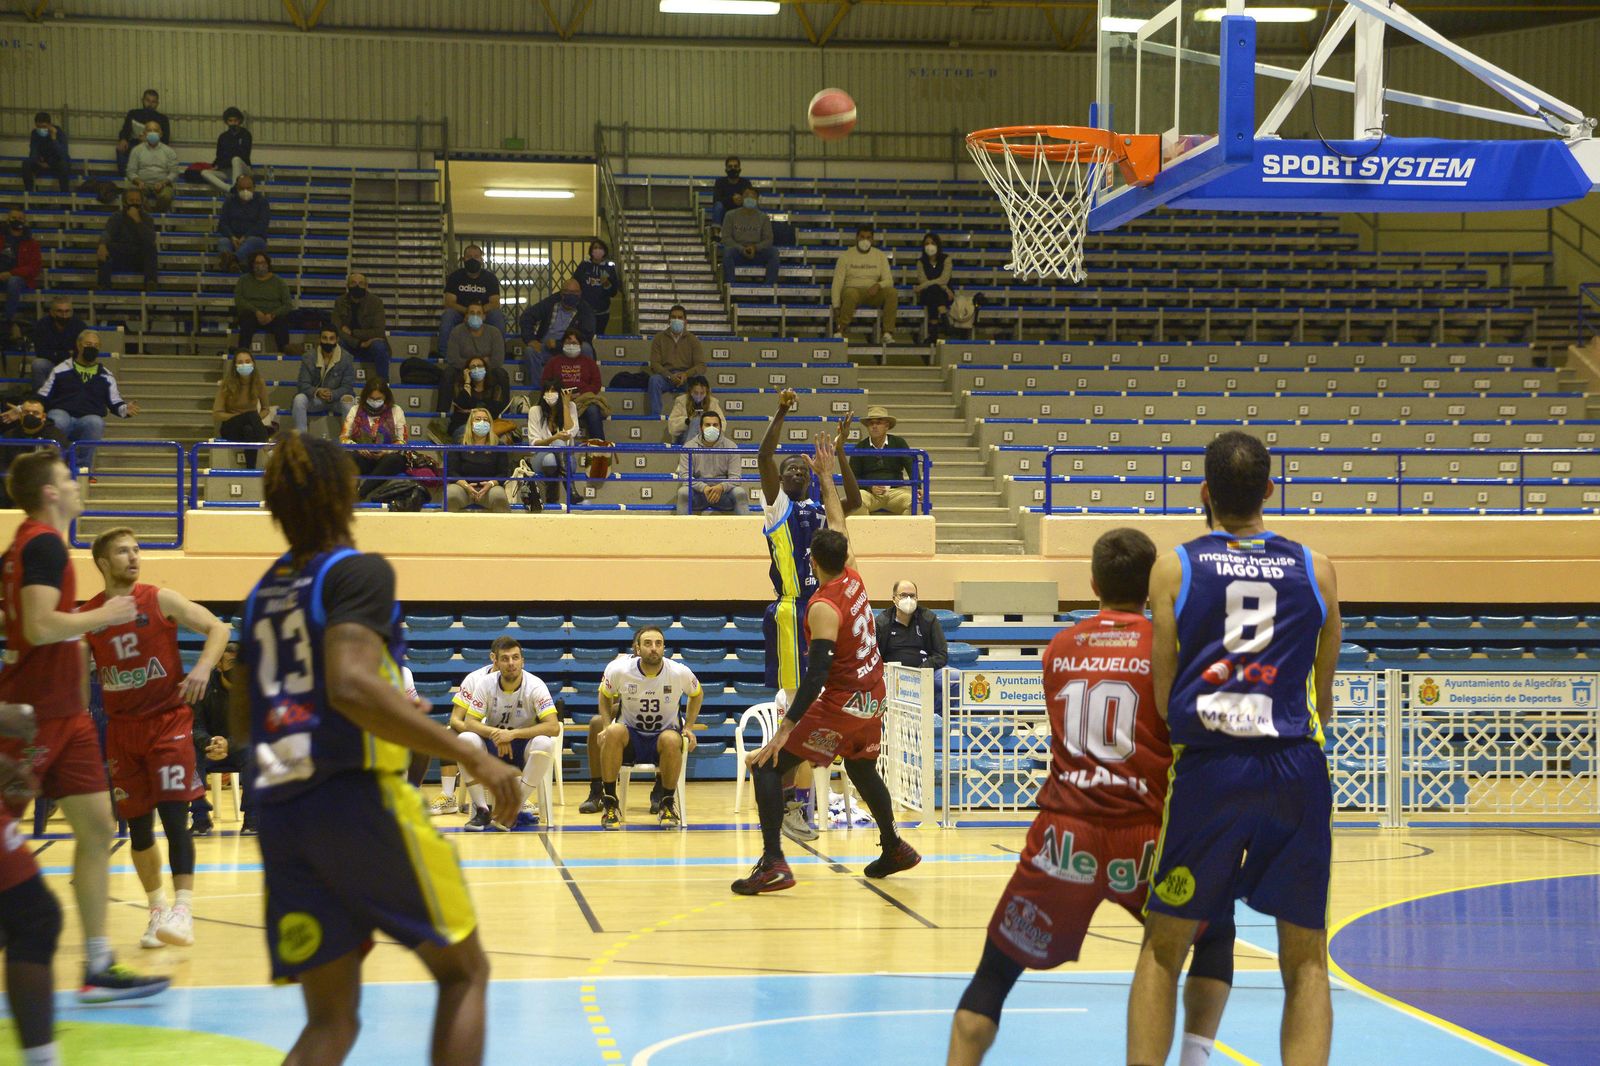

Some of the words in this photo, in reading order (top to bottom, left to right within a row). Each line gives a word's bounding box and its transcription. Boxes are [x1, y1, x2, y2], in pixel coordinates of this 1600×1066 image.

[1262, 154, 1358, 176] SPORT
[1359, 156, 1476, 184] SYSTEM
[459, 284, 486, 293] adidas
[1199, 552, 1296, 566] master.house
[1216, 562, 1258, 578] IAGO
[1261, 566, 1284, 579] ED
[1223, 580, 1277, 654] 8
[110, 632, 141, 661] 12
[254, 608, 314, 697] 13
[1052, 657, 1150, 674] PALAZUELOS
[1444, 678, 1510, 689] Ayuntamiento
[1524, 678, 1567, 689] Algeciras
[640, 699, 660, 712] 33
[1450, 694, 1502, 704] Delegación
[1519, 694, 1562, 704] Deportes
[1054, 679, 1139, 762] 10
[158, 764, 186, 790] 12
